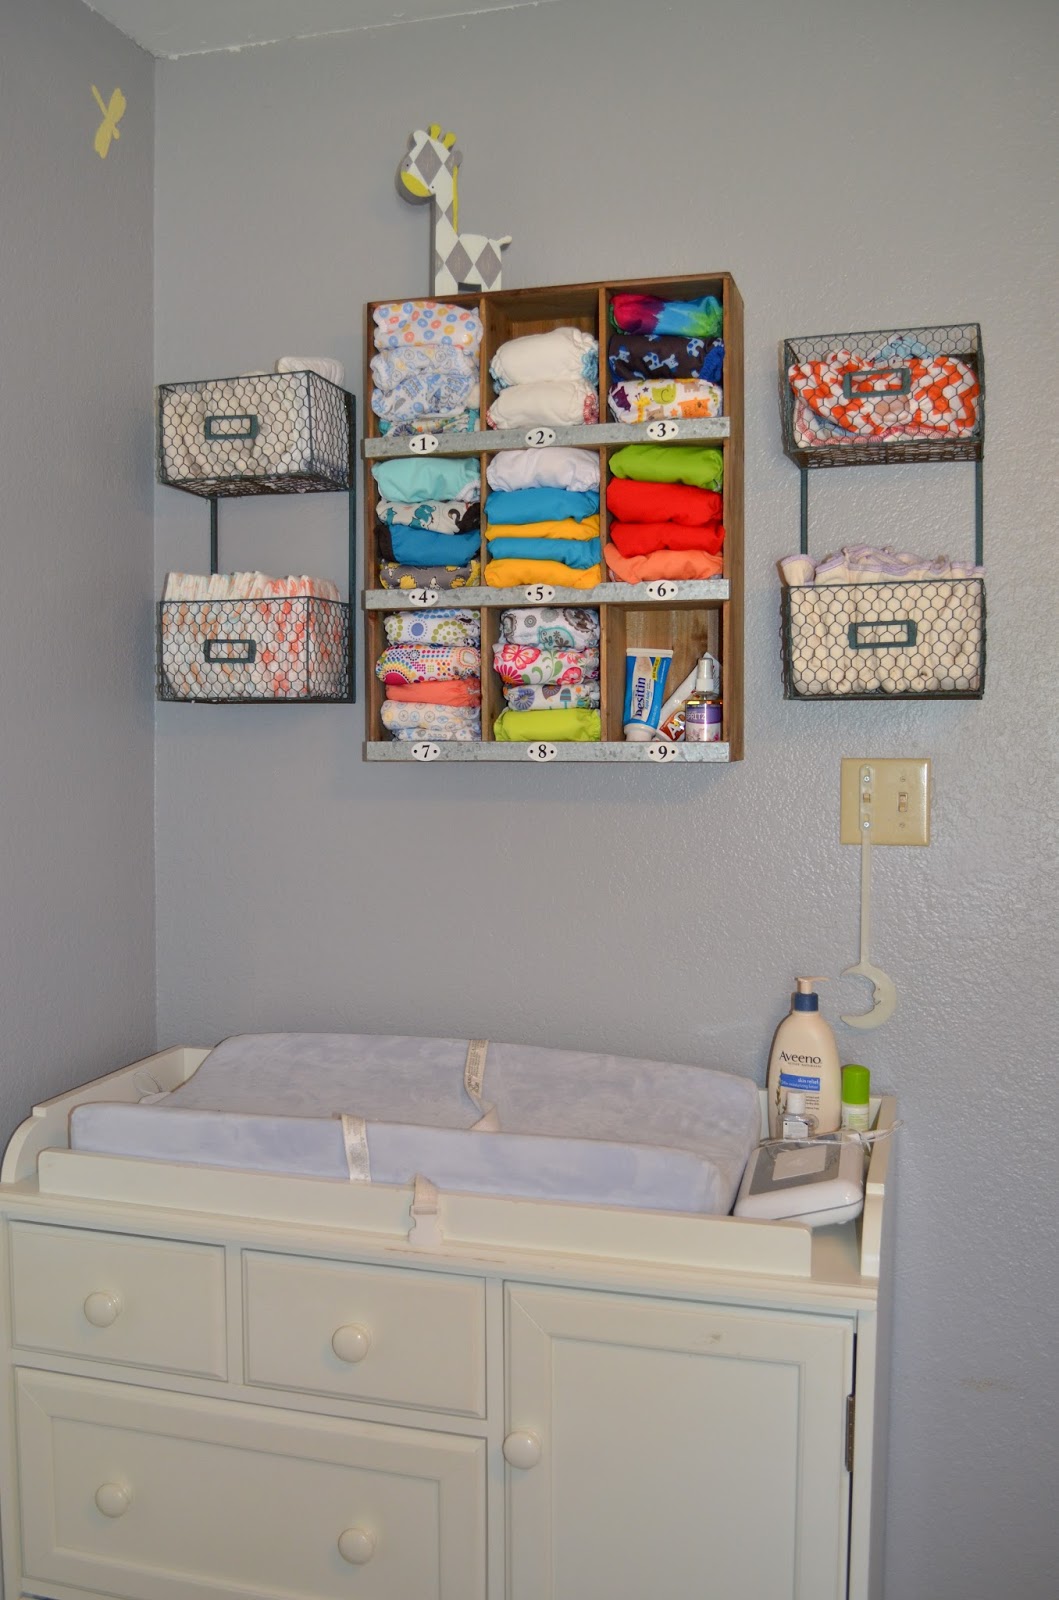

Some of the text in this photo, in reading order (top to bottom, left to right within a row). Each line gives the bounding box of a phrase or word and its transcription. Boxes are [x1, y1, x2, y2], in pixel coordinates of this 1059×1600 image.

[657, 422, 667, 437] 3
[420, 437, 427, 451] 1
[535, 430, 545, 445] 2
[418, 590, 428, 604] 4
[536, 586, 544, 601] 5
[657, 583, 667, 597] 6
[635, 677, 646, 717] Desitin
[421, 744, 430, 759] 7
[538, 744, 547, 759] 8
[658, 745, 668, 760] 9
[779, 1051, 821, 1065] Aveeno
